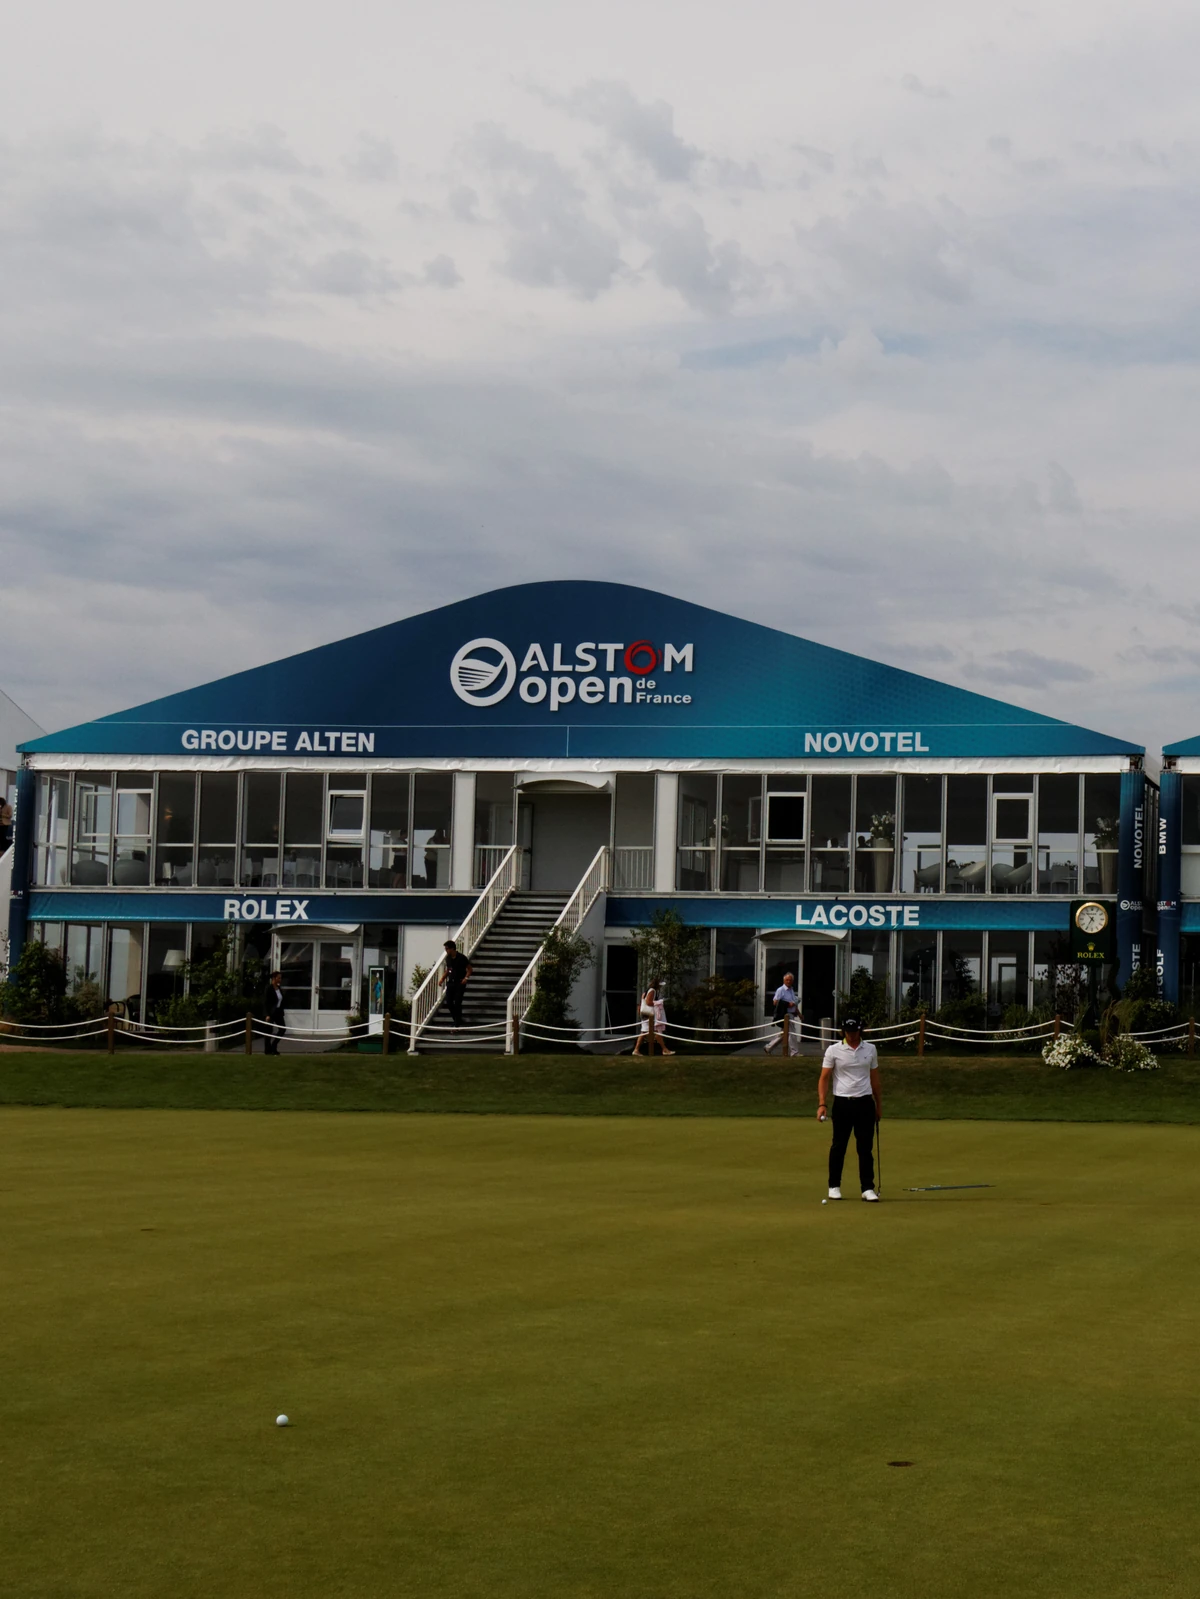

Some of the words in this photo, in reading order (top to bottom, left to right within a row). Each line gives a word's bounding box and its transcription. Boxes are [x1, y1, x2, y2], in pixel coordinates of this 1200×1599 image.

[520, 639, 694, 674] ALSTOM
[519, 676, 633, 711] open
[636, 678, 656, 689] de
[636, 692, 692, 704] France
[181, 730, 287, 752] GROUPE
[295, 730, 375, 753] ALTEN
[804, 731, 930, 752] NOVOTEL
[1134, 804, 1144, 868] NOVOTEL
[1159, 817, 1167, 854] BMW
[223, 899, 309, 921] ROLEX
[795, 904, 920, 926] LACOSTE
